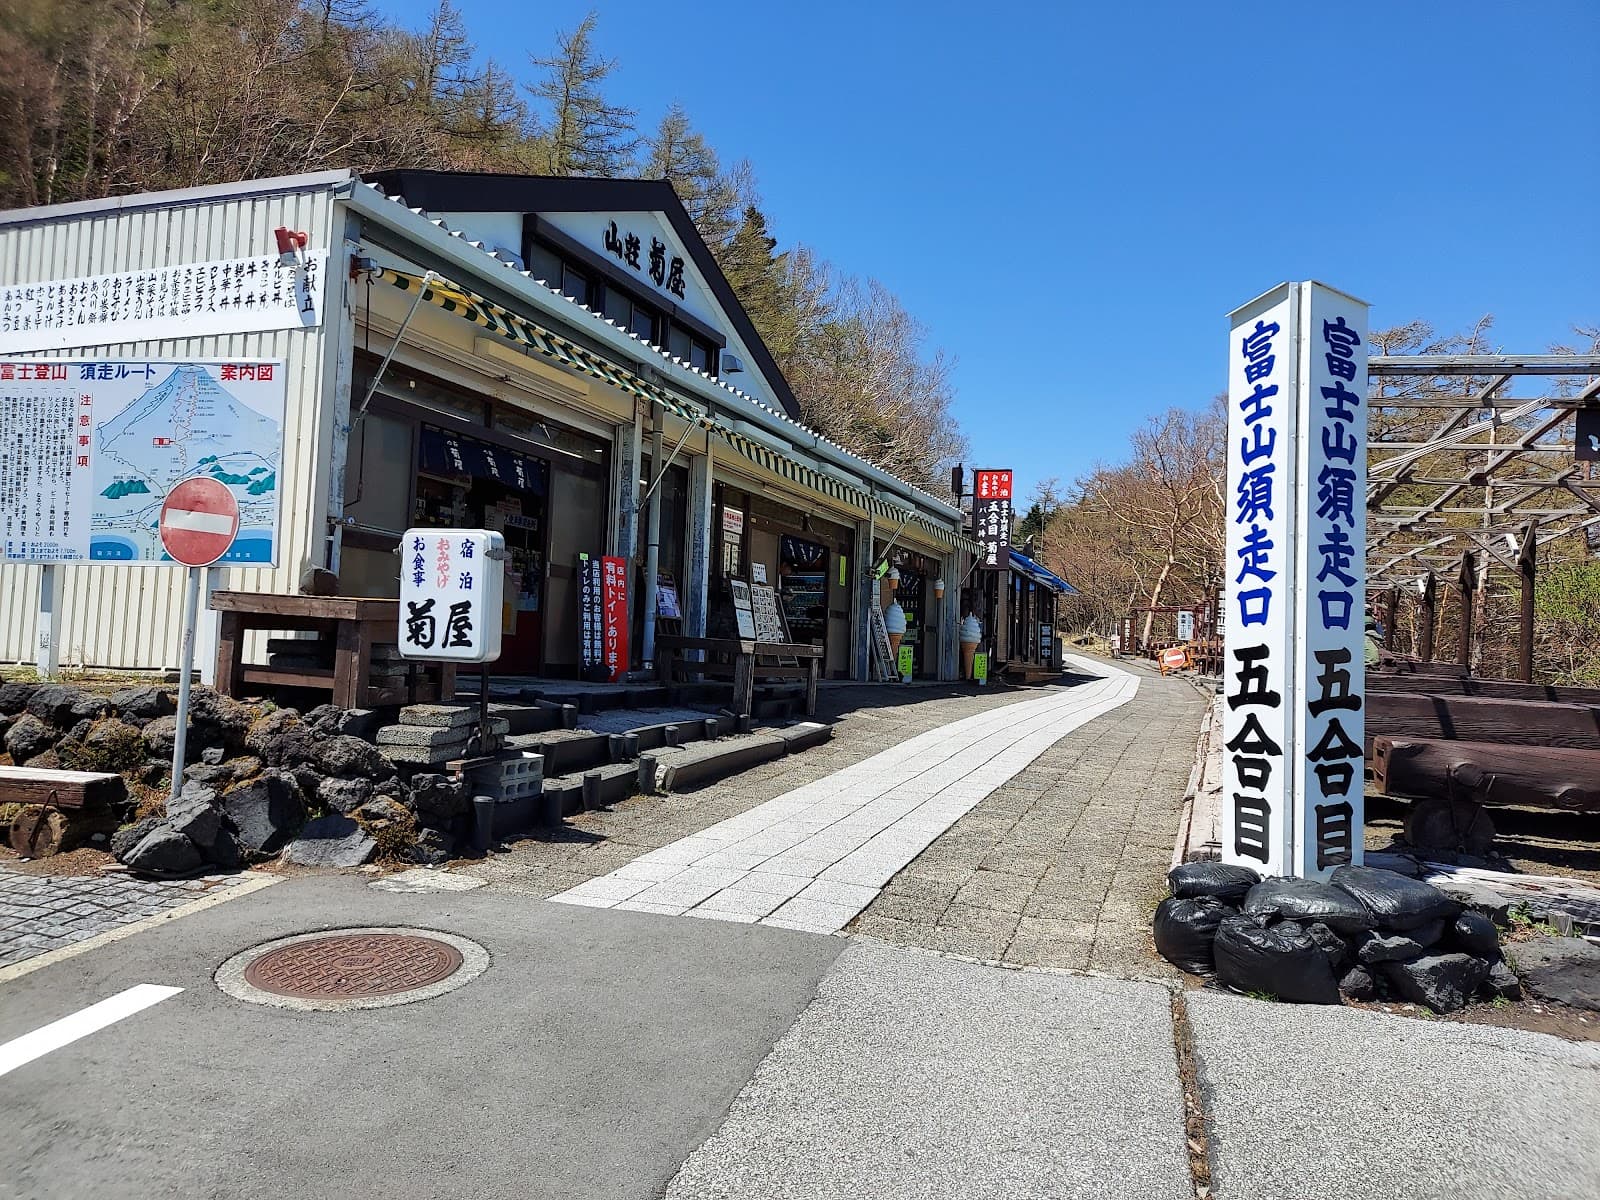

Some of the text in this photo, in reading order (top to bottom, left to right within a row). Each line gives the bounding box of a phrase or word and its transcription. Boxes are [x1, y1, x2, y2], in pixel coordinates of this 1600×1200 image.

[206, 265, 218, 313] カレーライス
[219, 263, 232, 311] 中華丼
[232, 262, 246, 310] 親子丼
[301, 256, 318, 313] お献立
[648, 236, 686, 301] 菊屋
[44, 285, 55, 329] とん汁
[77, 281, 89, 325] おでん
[122, 276, 133, 321] ラーメン
[0, 363, 274, 382] 富士登山 須走ルート 案内図
[78, 394, 91, 467] 注意事項
[987, 500, 1000, 536] 五合目
[411, 536, 426, 588] お食事
[436, 537, 451, 589] おみやげ
[459, 537, 476, 591] 宿泊
[616, 566, 625, 601] 店内に
[605, 561, 618, 677] 有料トイレあります
[1226, 320, 1283, 866] 富士山須走口 五合目
[1306, 315, 1363, 871] 富士山須走口 五合目
[406, 598, 473, 650] 菊屋
